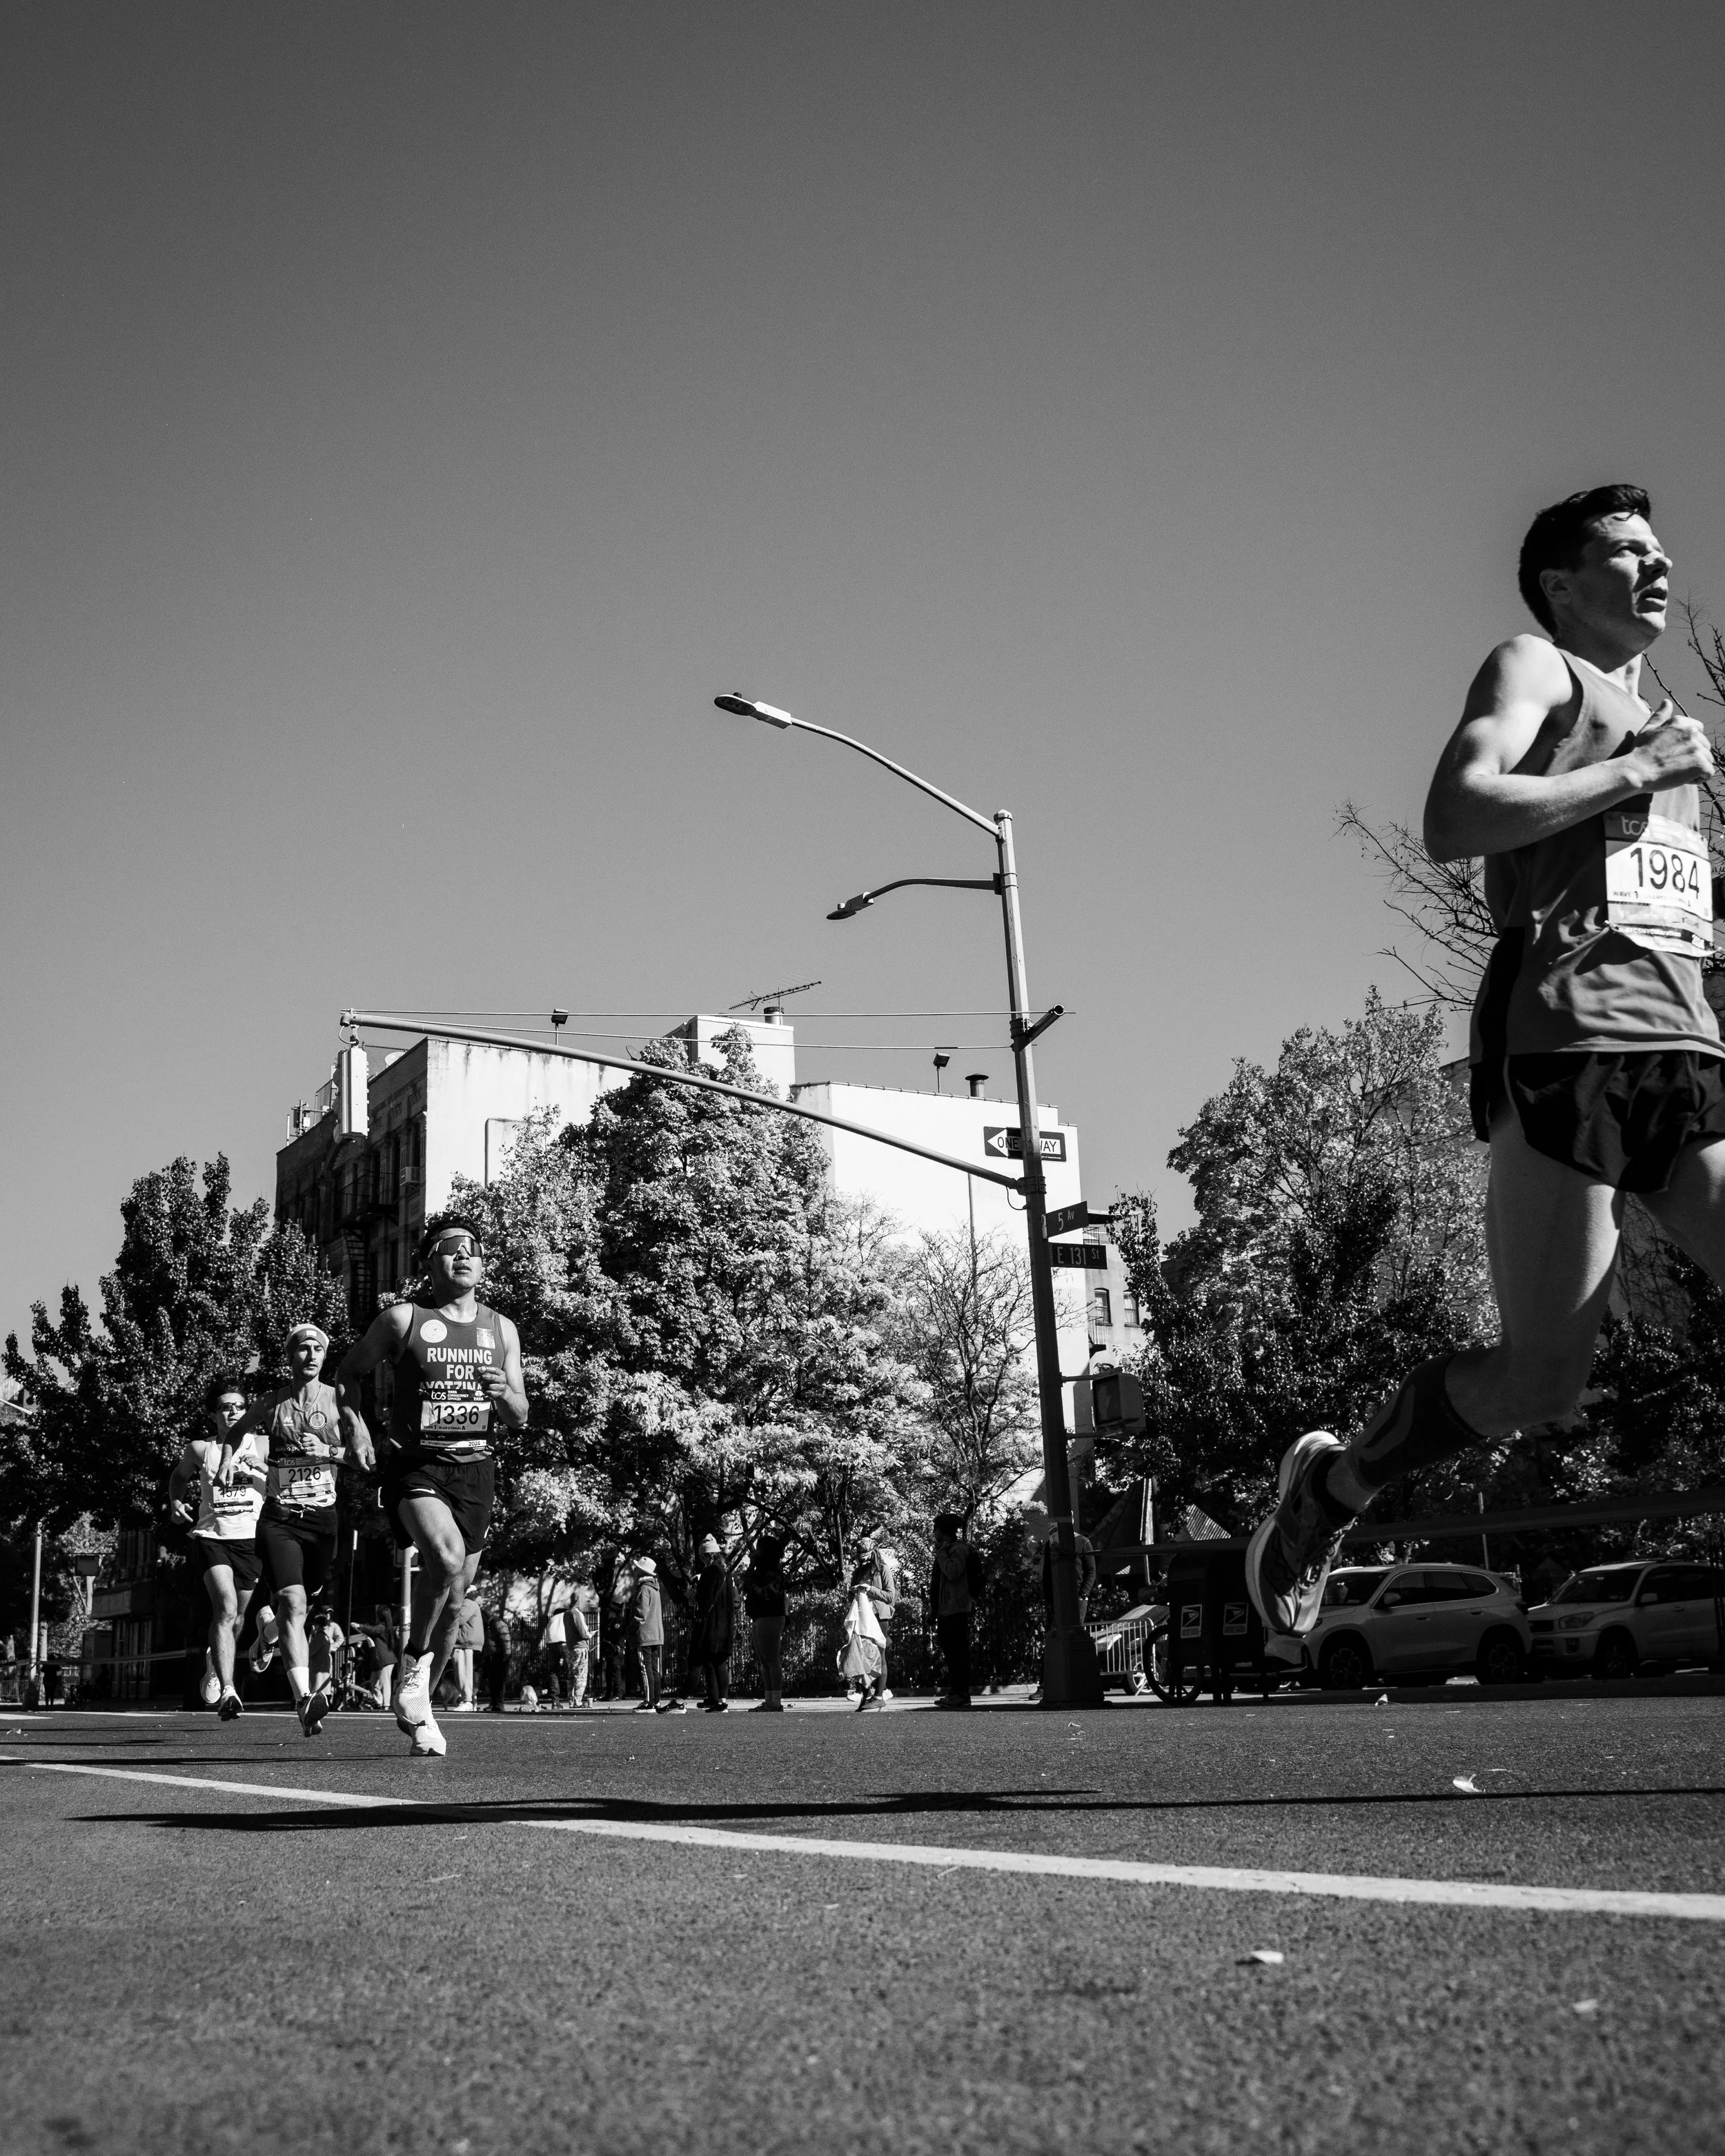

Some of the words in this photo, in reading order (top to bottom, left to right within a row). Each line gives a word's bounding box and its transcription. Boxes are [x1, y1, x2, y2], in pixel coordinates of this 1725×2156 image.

[1630, 847, 1700, 900] 1984
[997, 1136, 1020, 1150] ONE
[1058, 1212, 1064, 1231] 5
[1067, 1209, 1074, 1221] Av
[1057, 1247, 1064, 1264] E
[1070, 1247, 1087, 1265] 131
[1092, 1247, 1100, 1260] St
[427, 1347, 492, 1365] RUNNING
[446, 1364, 474, 1380] FOR
[431, 1390, 446, 1400] tcs
[434, 1405, 480, 1425] 1336
[288, 1466, 321, 1483] 2126
[218, 1485, 246, 1498] 1579
